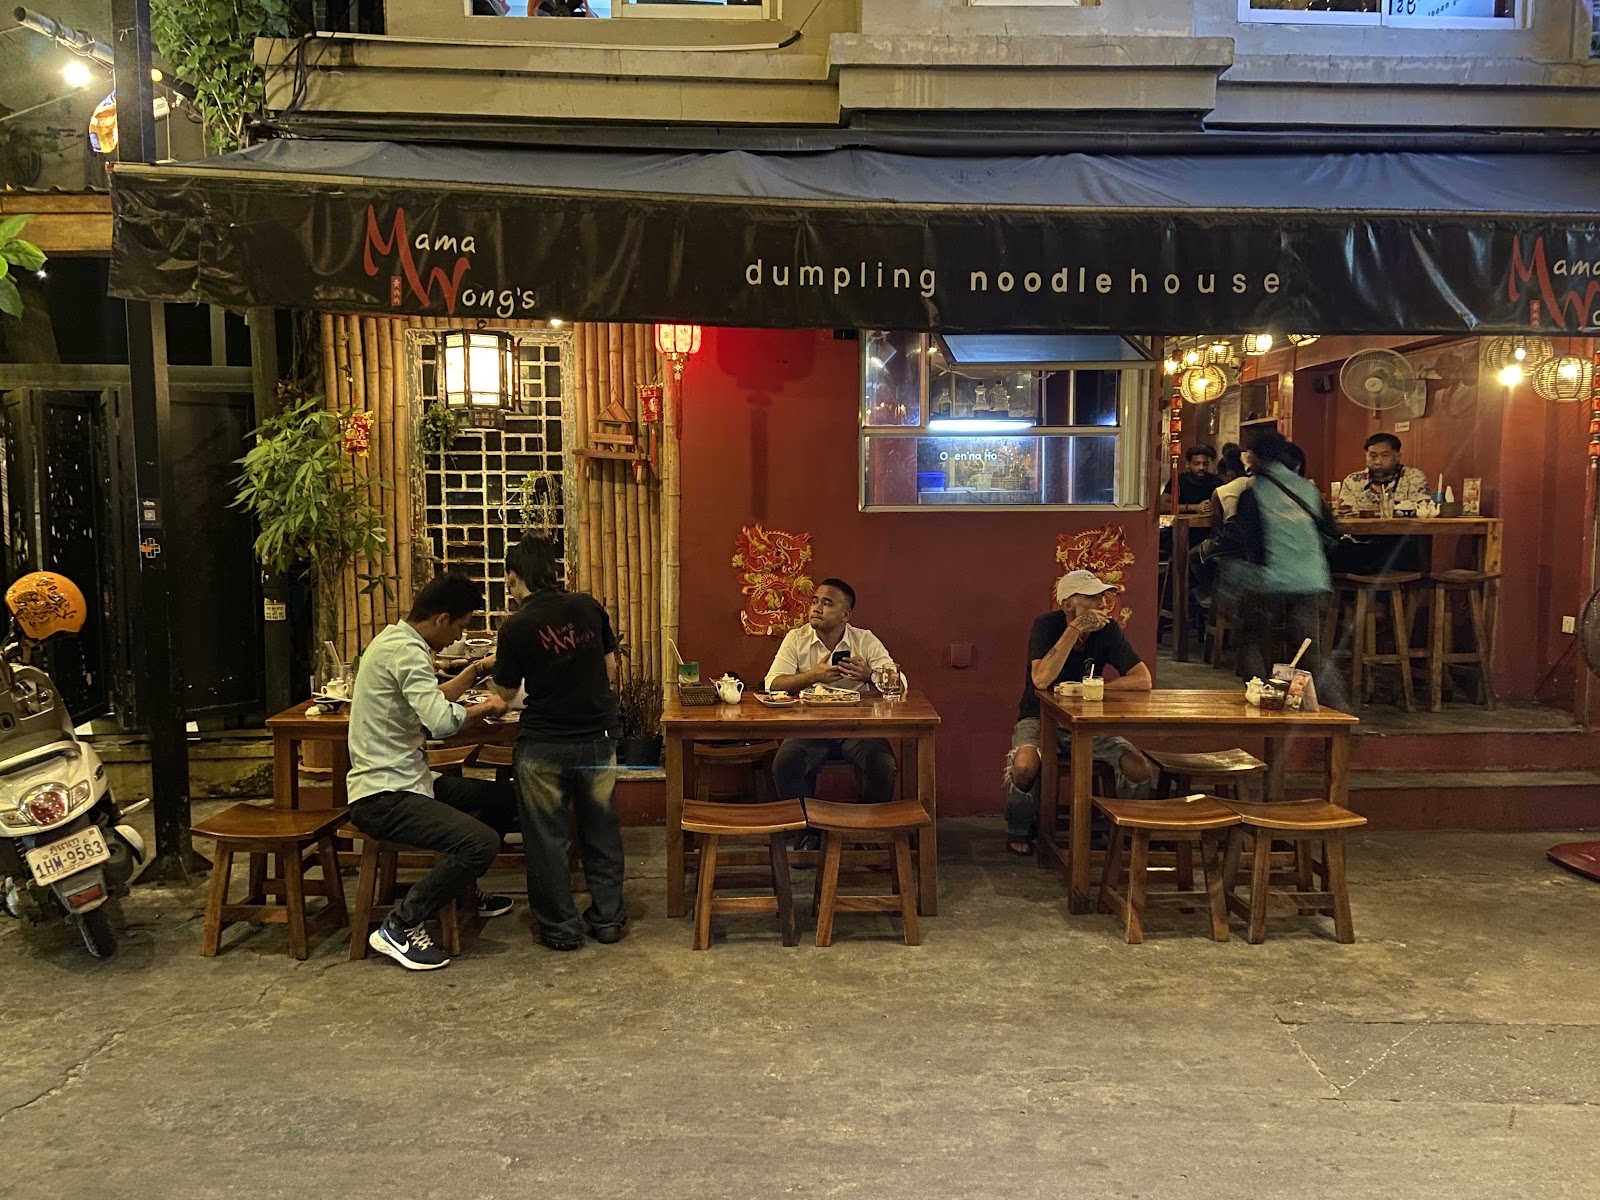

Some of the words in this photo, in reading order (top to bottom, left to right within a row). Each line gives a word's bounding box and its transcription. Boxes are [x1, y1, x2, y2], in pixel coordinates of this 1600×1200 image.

[363, 203, 477, 308] Mama
[745, 258, 936, 298] dumpling
[970, 266, 1113, 293] noodle
[1130, 268, 1281, 294] house
[427, 256, 536, 319] Wong's
